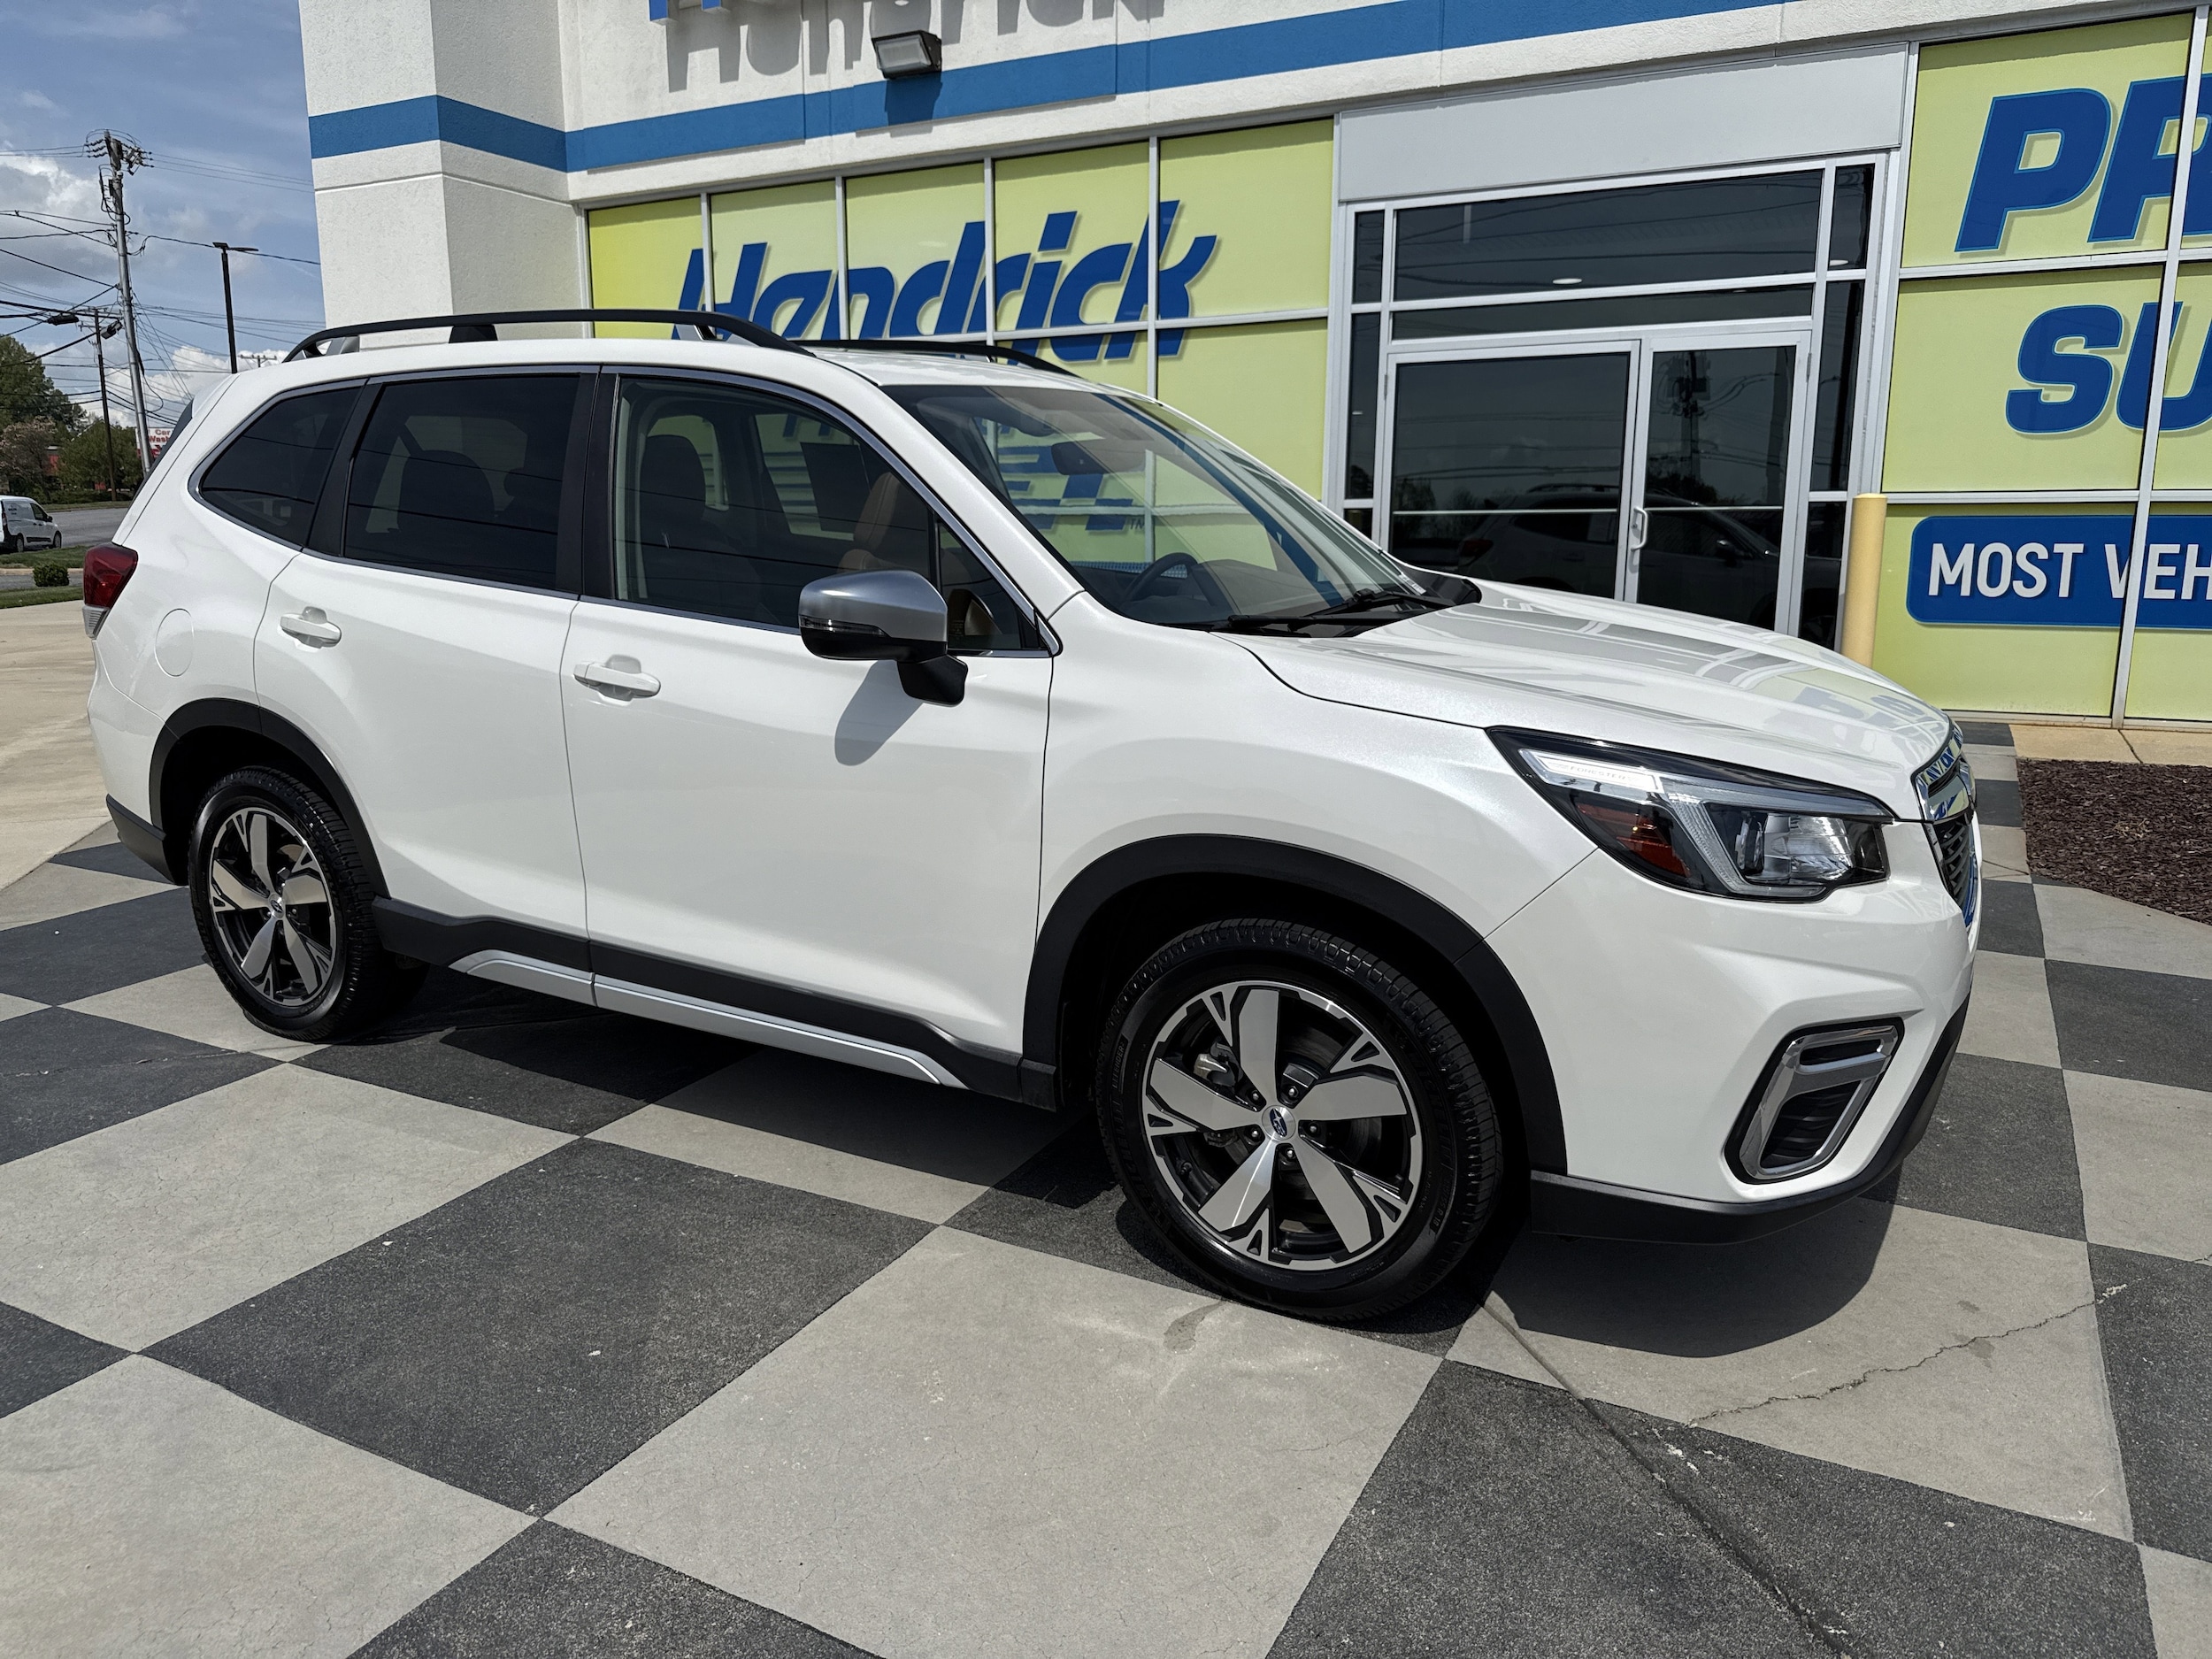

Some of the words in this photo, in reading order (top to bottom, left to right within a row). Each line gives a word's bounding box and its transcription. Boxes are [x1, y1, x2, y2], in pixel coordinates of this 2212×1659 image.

[671, 199, 1218, 365] Hendrick
[2005, 301, 2212, 434] SU
[1928, 541, 2085, 598] MOST
[2104, 543, 2212, 600] VEH
[1570, 765, 1626, 780] FORESTER
